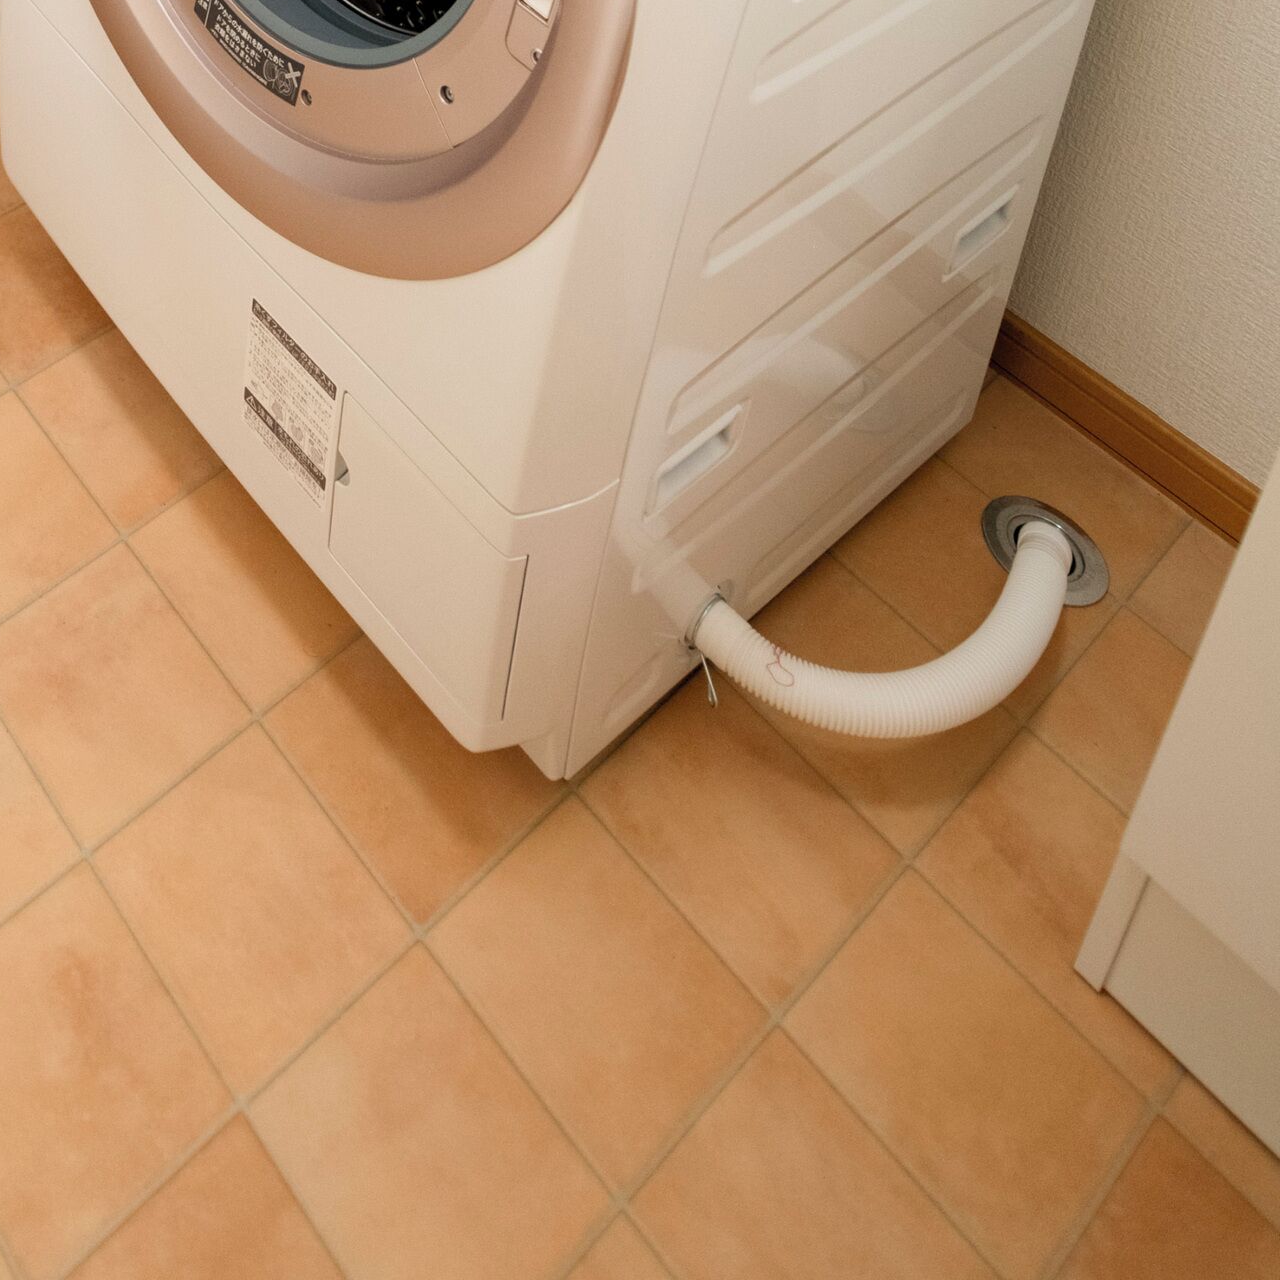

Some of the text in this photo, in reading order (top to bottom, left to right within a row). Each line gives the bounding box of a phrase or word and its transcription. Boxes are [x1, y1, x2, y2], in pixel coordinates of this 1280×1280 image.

[214, 24, 257, 68] 衣類をはさまない
[216, 14, 262, 62] ドアを閉めるときに
